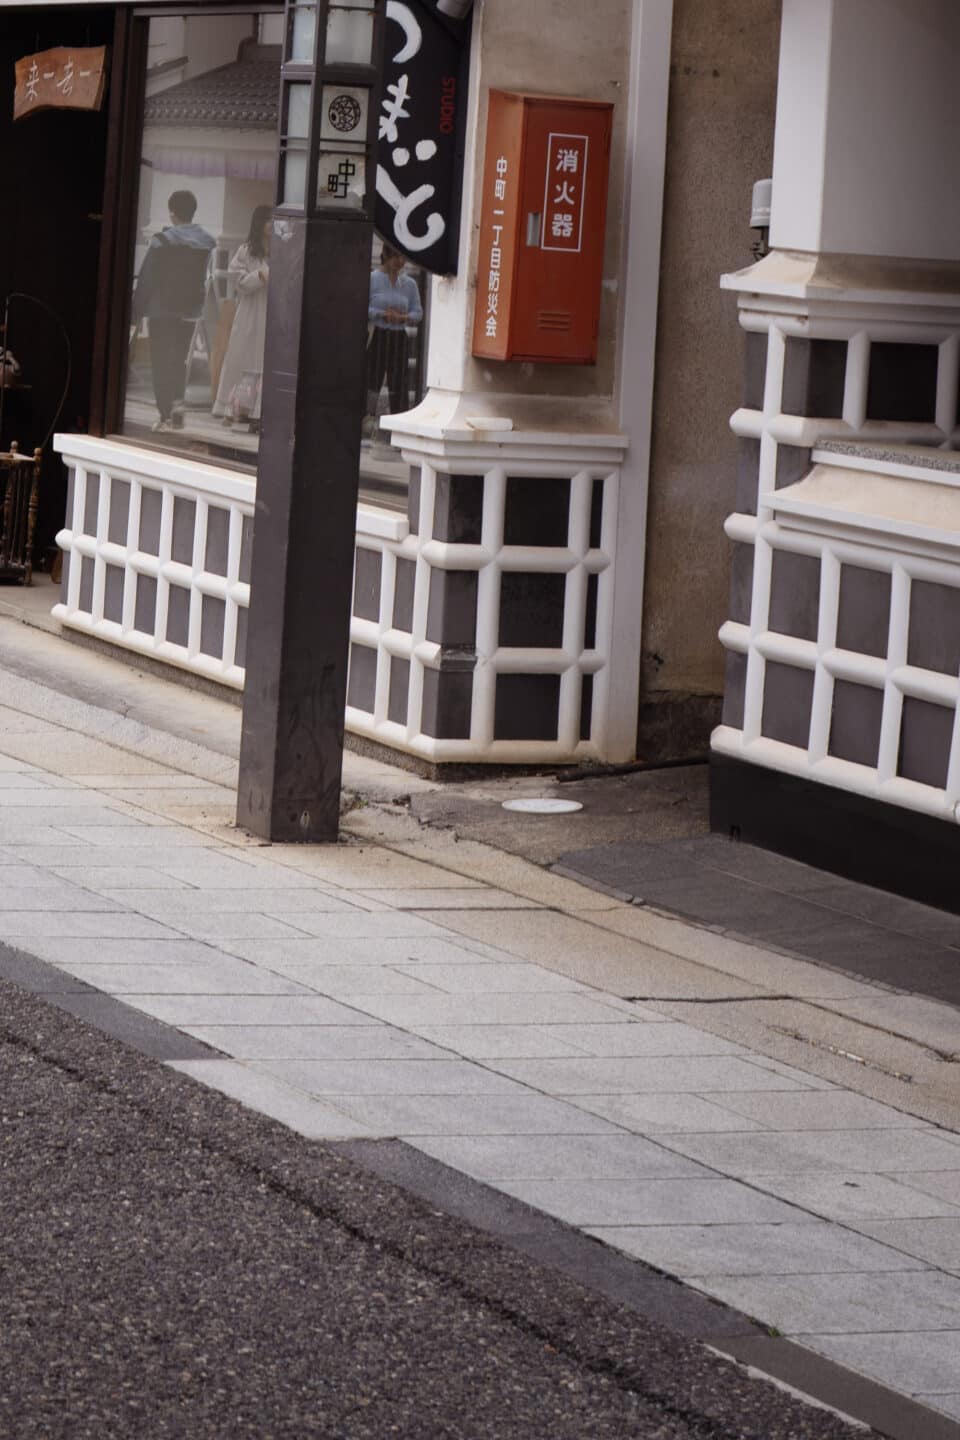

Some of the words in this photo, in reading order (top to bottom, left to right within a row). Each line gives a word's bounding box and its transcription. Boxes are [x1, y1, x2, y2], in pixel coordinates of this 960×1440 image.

[439, 77, 456, 135] STUDIO
[327, 157, 356, 199] 中町
[551, 147, 579, 238] 消火器
[485, 156, 508, 338] 中町一丁目防災会
